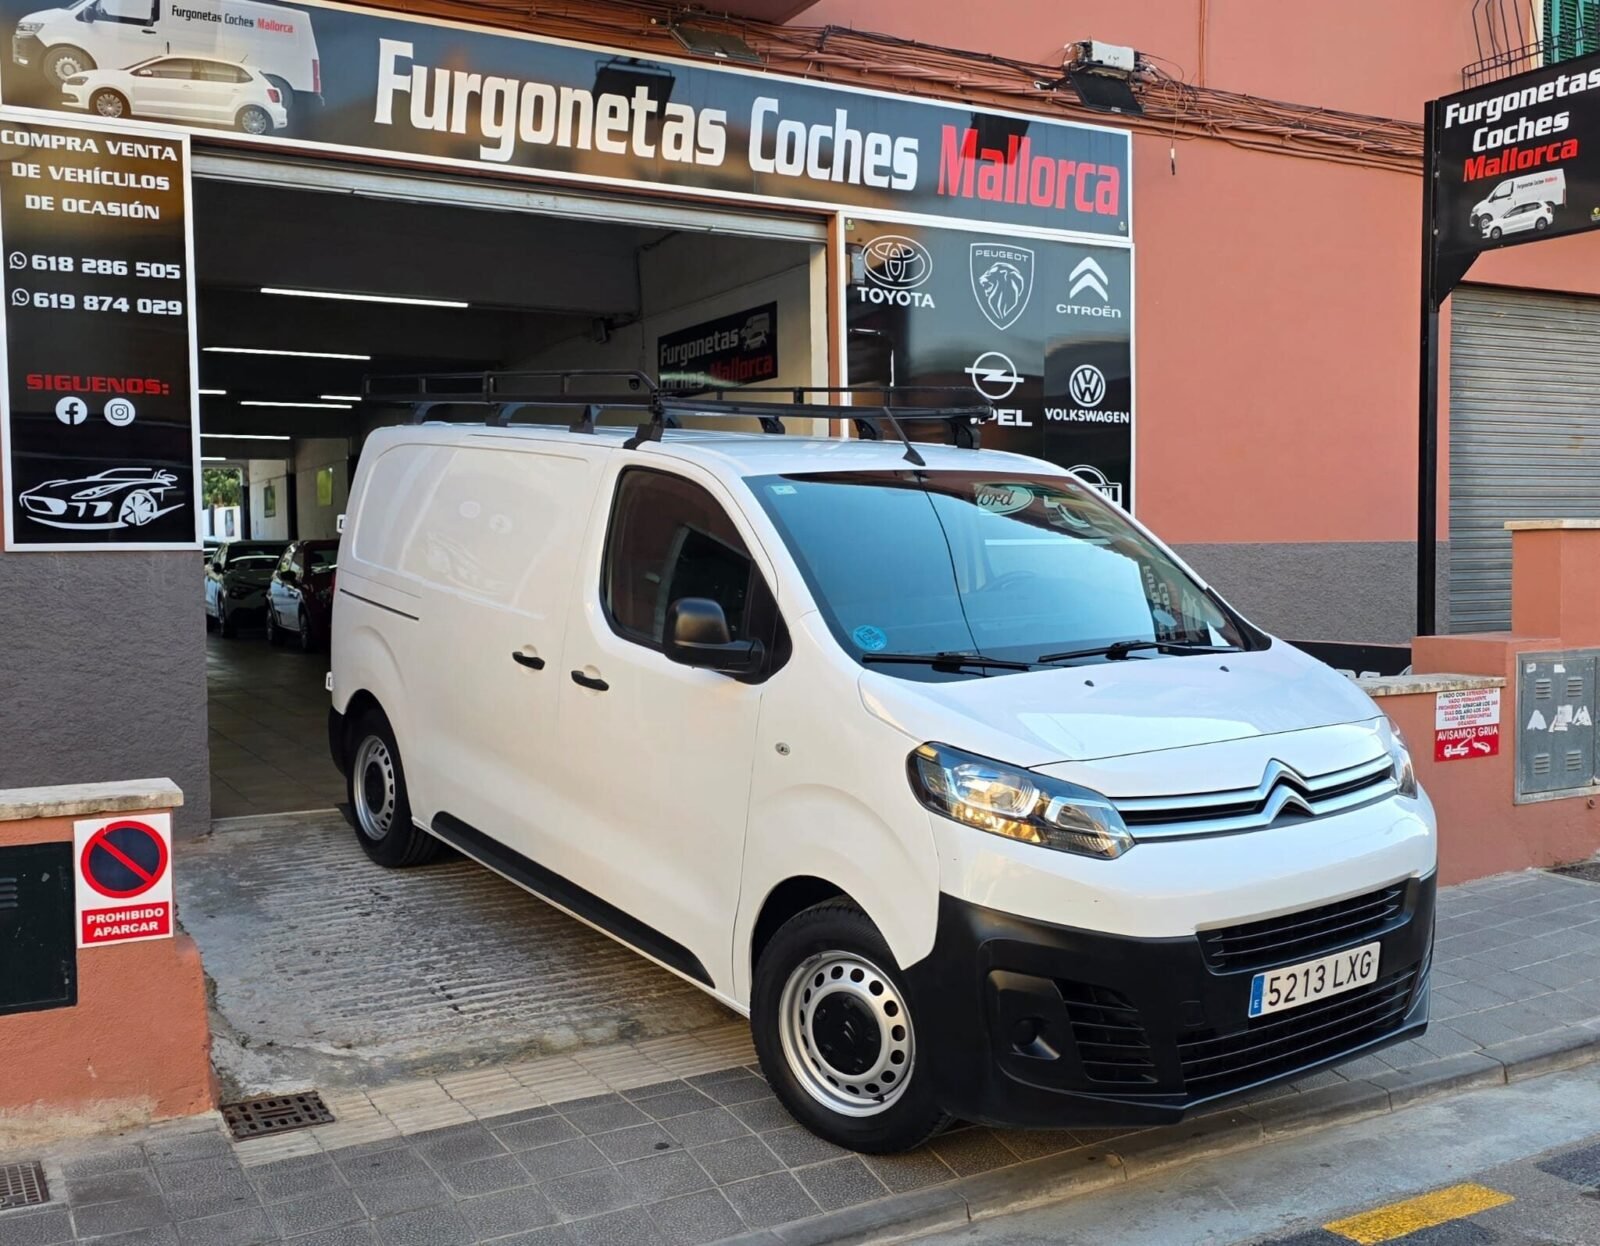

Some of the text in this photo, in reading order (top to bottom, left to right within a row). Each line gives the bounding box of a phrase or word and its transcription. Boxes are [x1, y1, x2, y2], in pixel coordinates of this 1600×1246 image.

[171, 5, 294, 33] Furgonetas Coches Mallorca
[1444, 68, 1600, 129] Furgonetas
[374, 38, 1121, 216] Furgonetas Coches Mallorca
[1472, 111, 1570, 152] Coches
[0, 129, 178, 161] COMPRA VENTA
[1463, 138, 1579, 182] Mallorca
[11, 162, 170, 191] DE VEHÍCULOS
[25, 194, 160, 220] DE OCASIÓN
[31, 254, 181, 279] 618 286 505
[975, 249, 1029, 262] PEUGEOT
[33, 292, 183, 315] 619 874 029
[857, 286, 935, 308] TOYOTA
[660, 329, 739, 366] Furgonetas
[710, 354, 773, 381] Mallorca
[26, 374, 169, 395] SIGUENOS:
[969, 408, 1033, 427] PEL
[1045, 408, 1130, 423] VOLKSWAGEN
[1437, 726, 1499, 741] AVISAMOS GRUA
[86, 907, 164, 925] PROHIBIDO
[93, 921, 158, 937] APARCAR
[1268, 950, 1372, 1007] 5213 LXG
